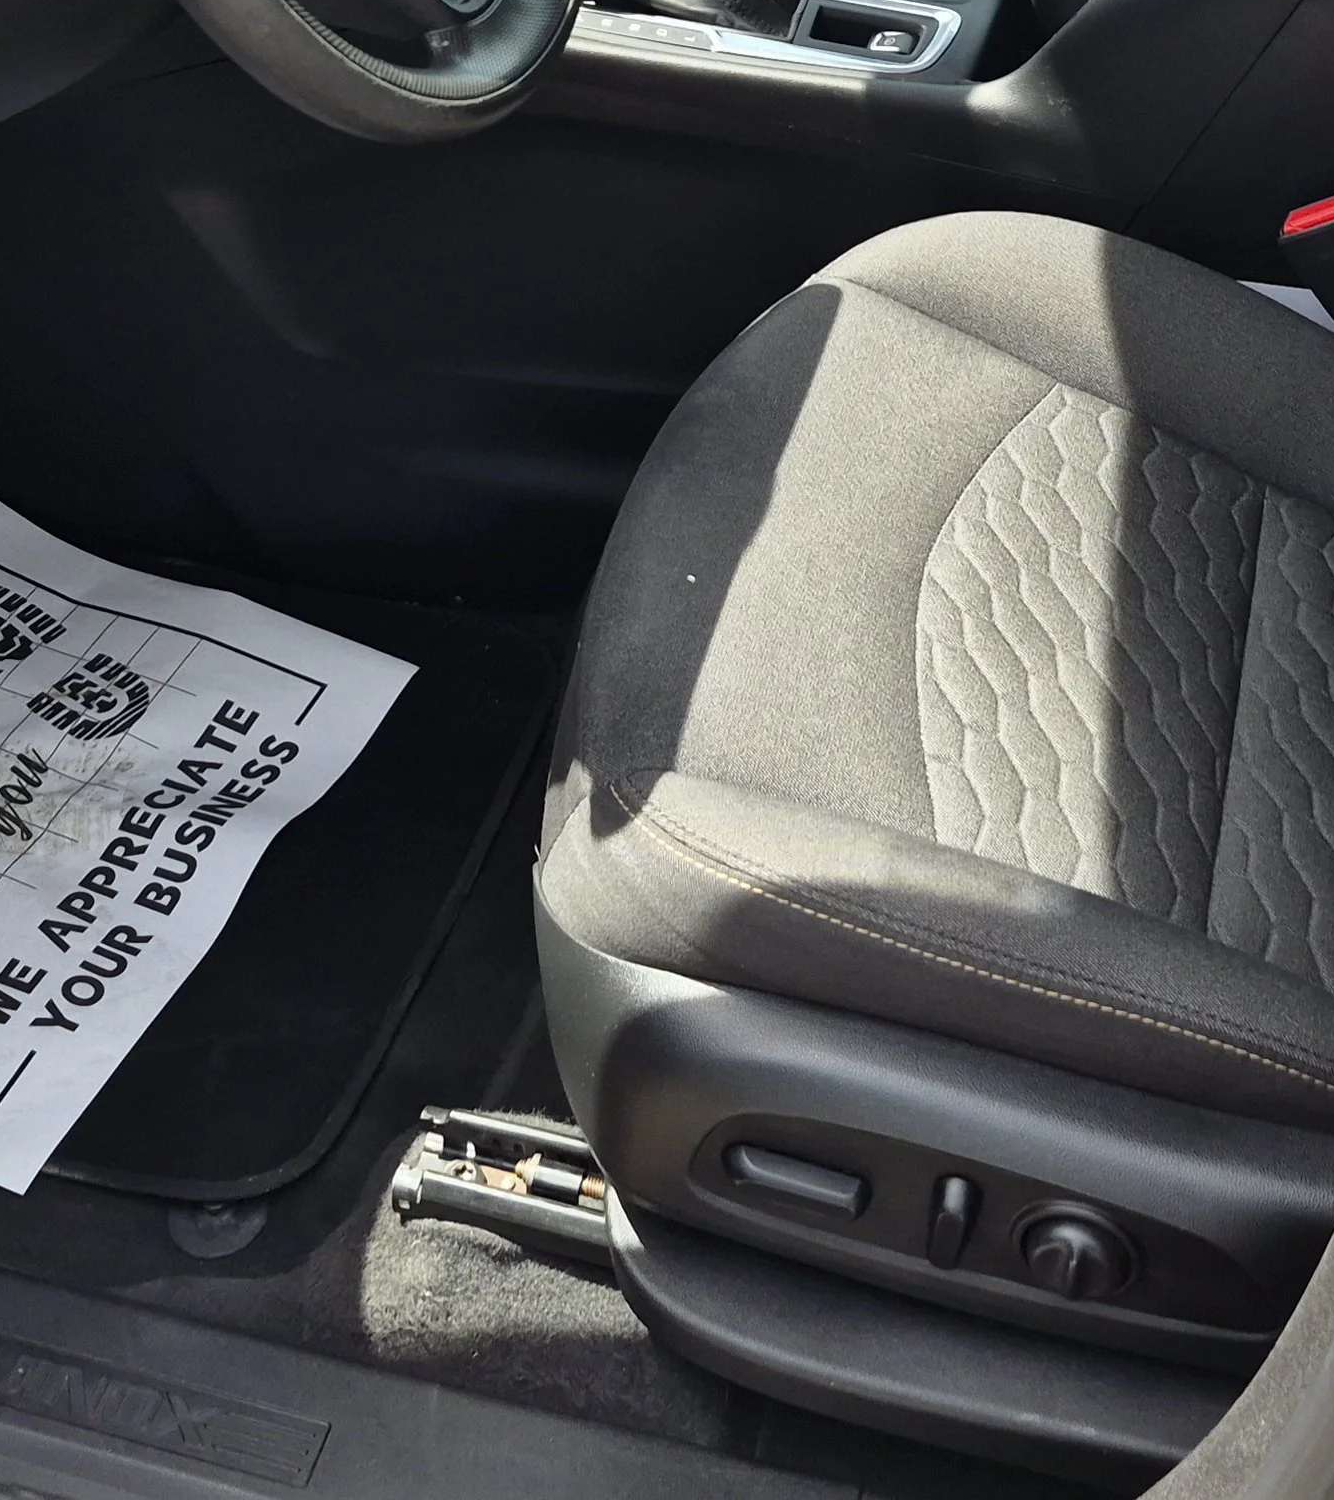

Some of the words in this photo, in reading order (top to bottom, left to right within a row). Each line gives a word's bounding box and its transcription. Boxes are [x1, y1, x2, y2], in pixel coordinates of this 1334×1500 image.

[28, 924, 155, 1033] YOUR
[133, 734, 301, 918] BUSINESS
[37, 698, 261, 954] APPRECIATE
